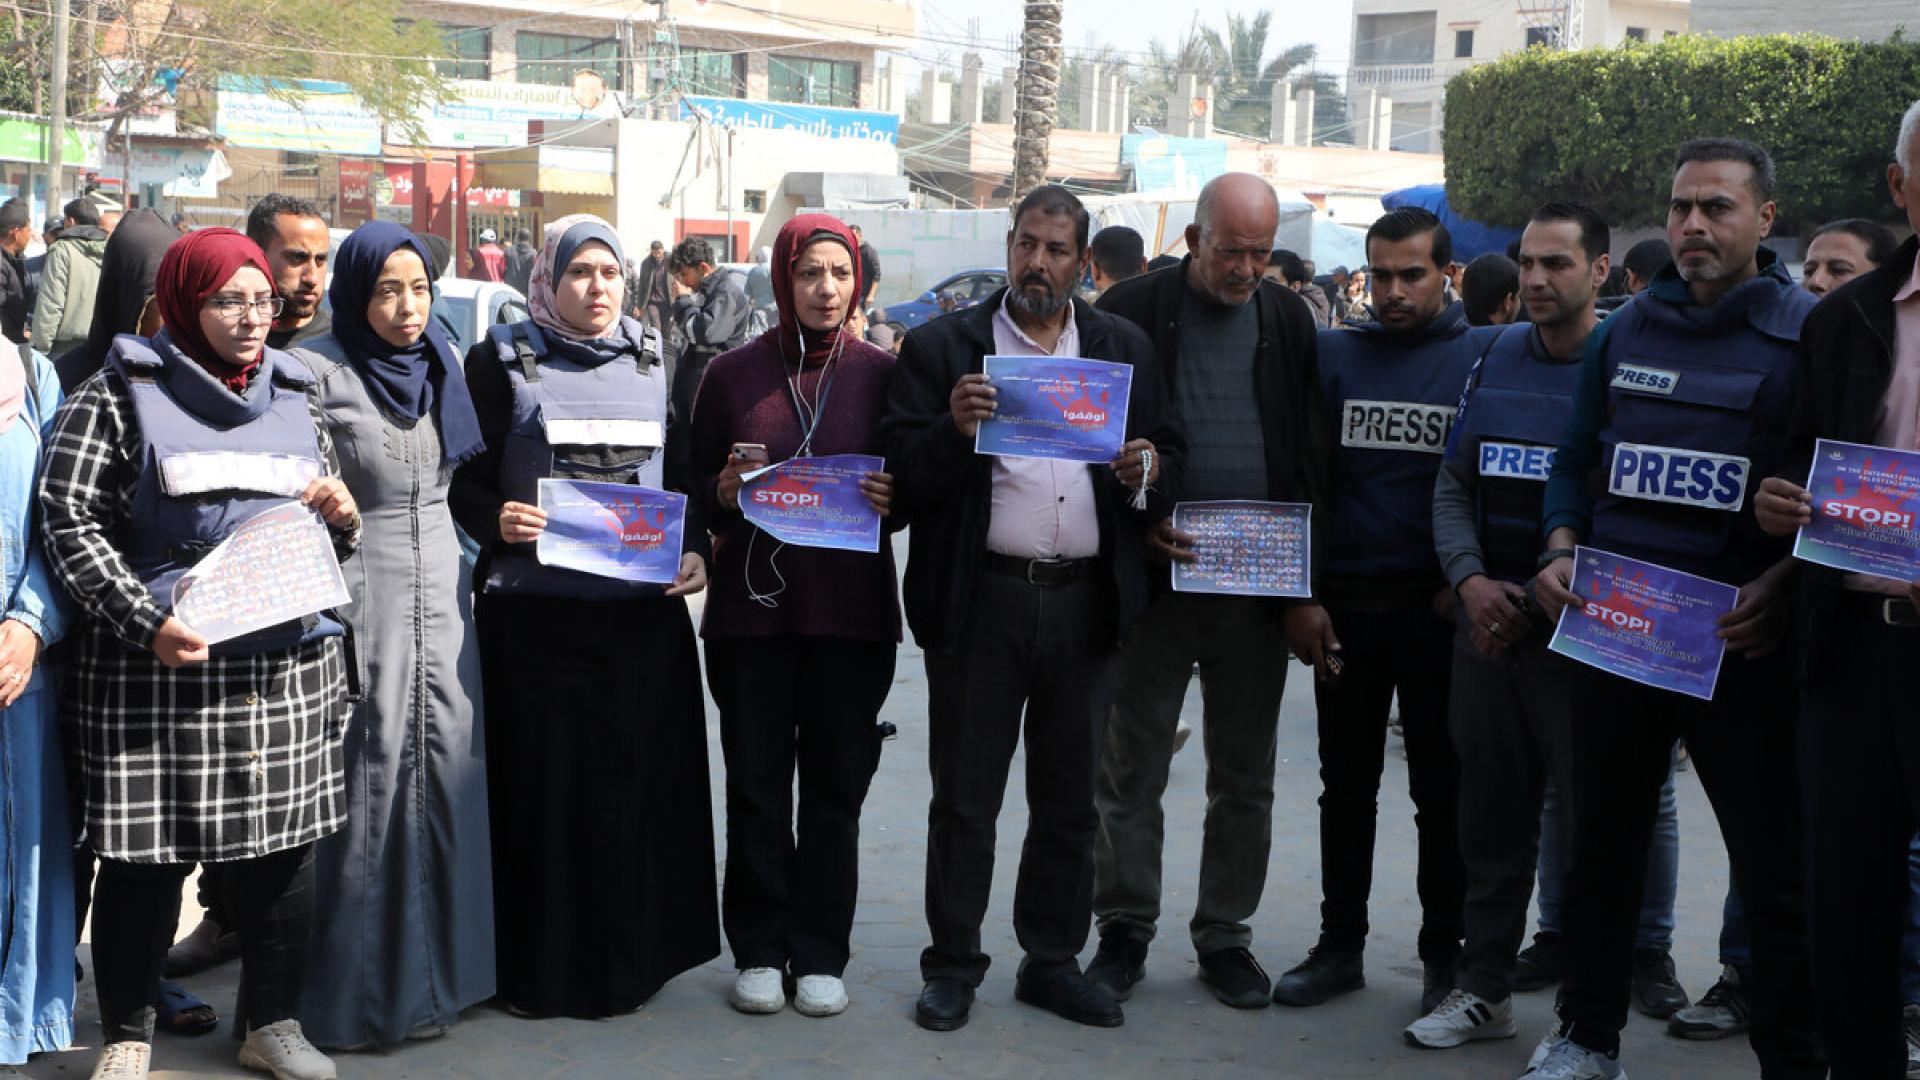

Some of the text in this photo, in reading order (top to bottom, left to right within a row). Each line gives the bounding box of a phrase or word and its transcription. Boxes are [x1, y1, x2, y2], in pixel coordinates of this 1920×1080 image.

[1615, 368, 1672, 389] PRESS
[1349, 406, 1443, 447] PRESS
[1614, 450, 1743, 504] PRESS
[755, 490, 819, 506] STOP!
[1824, 502, 1911, 528] STOP!
[1584, 603, 1652, 634] STOP!
